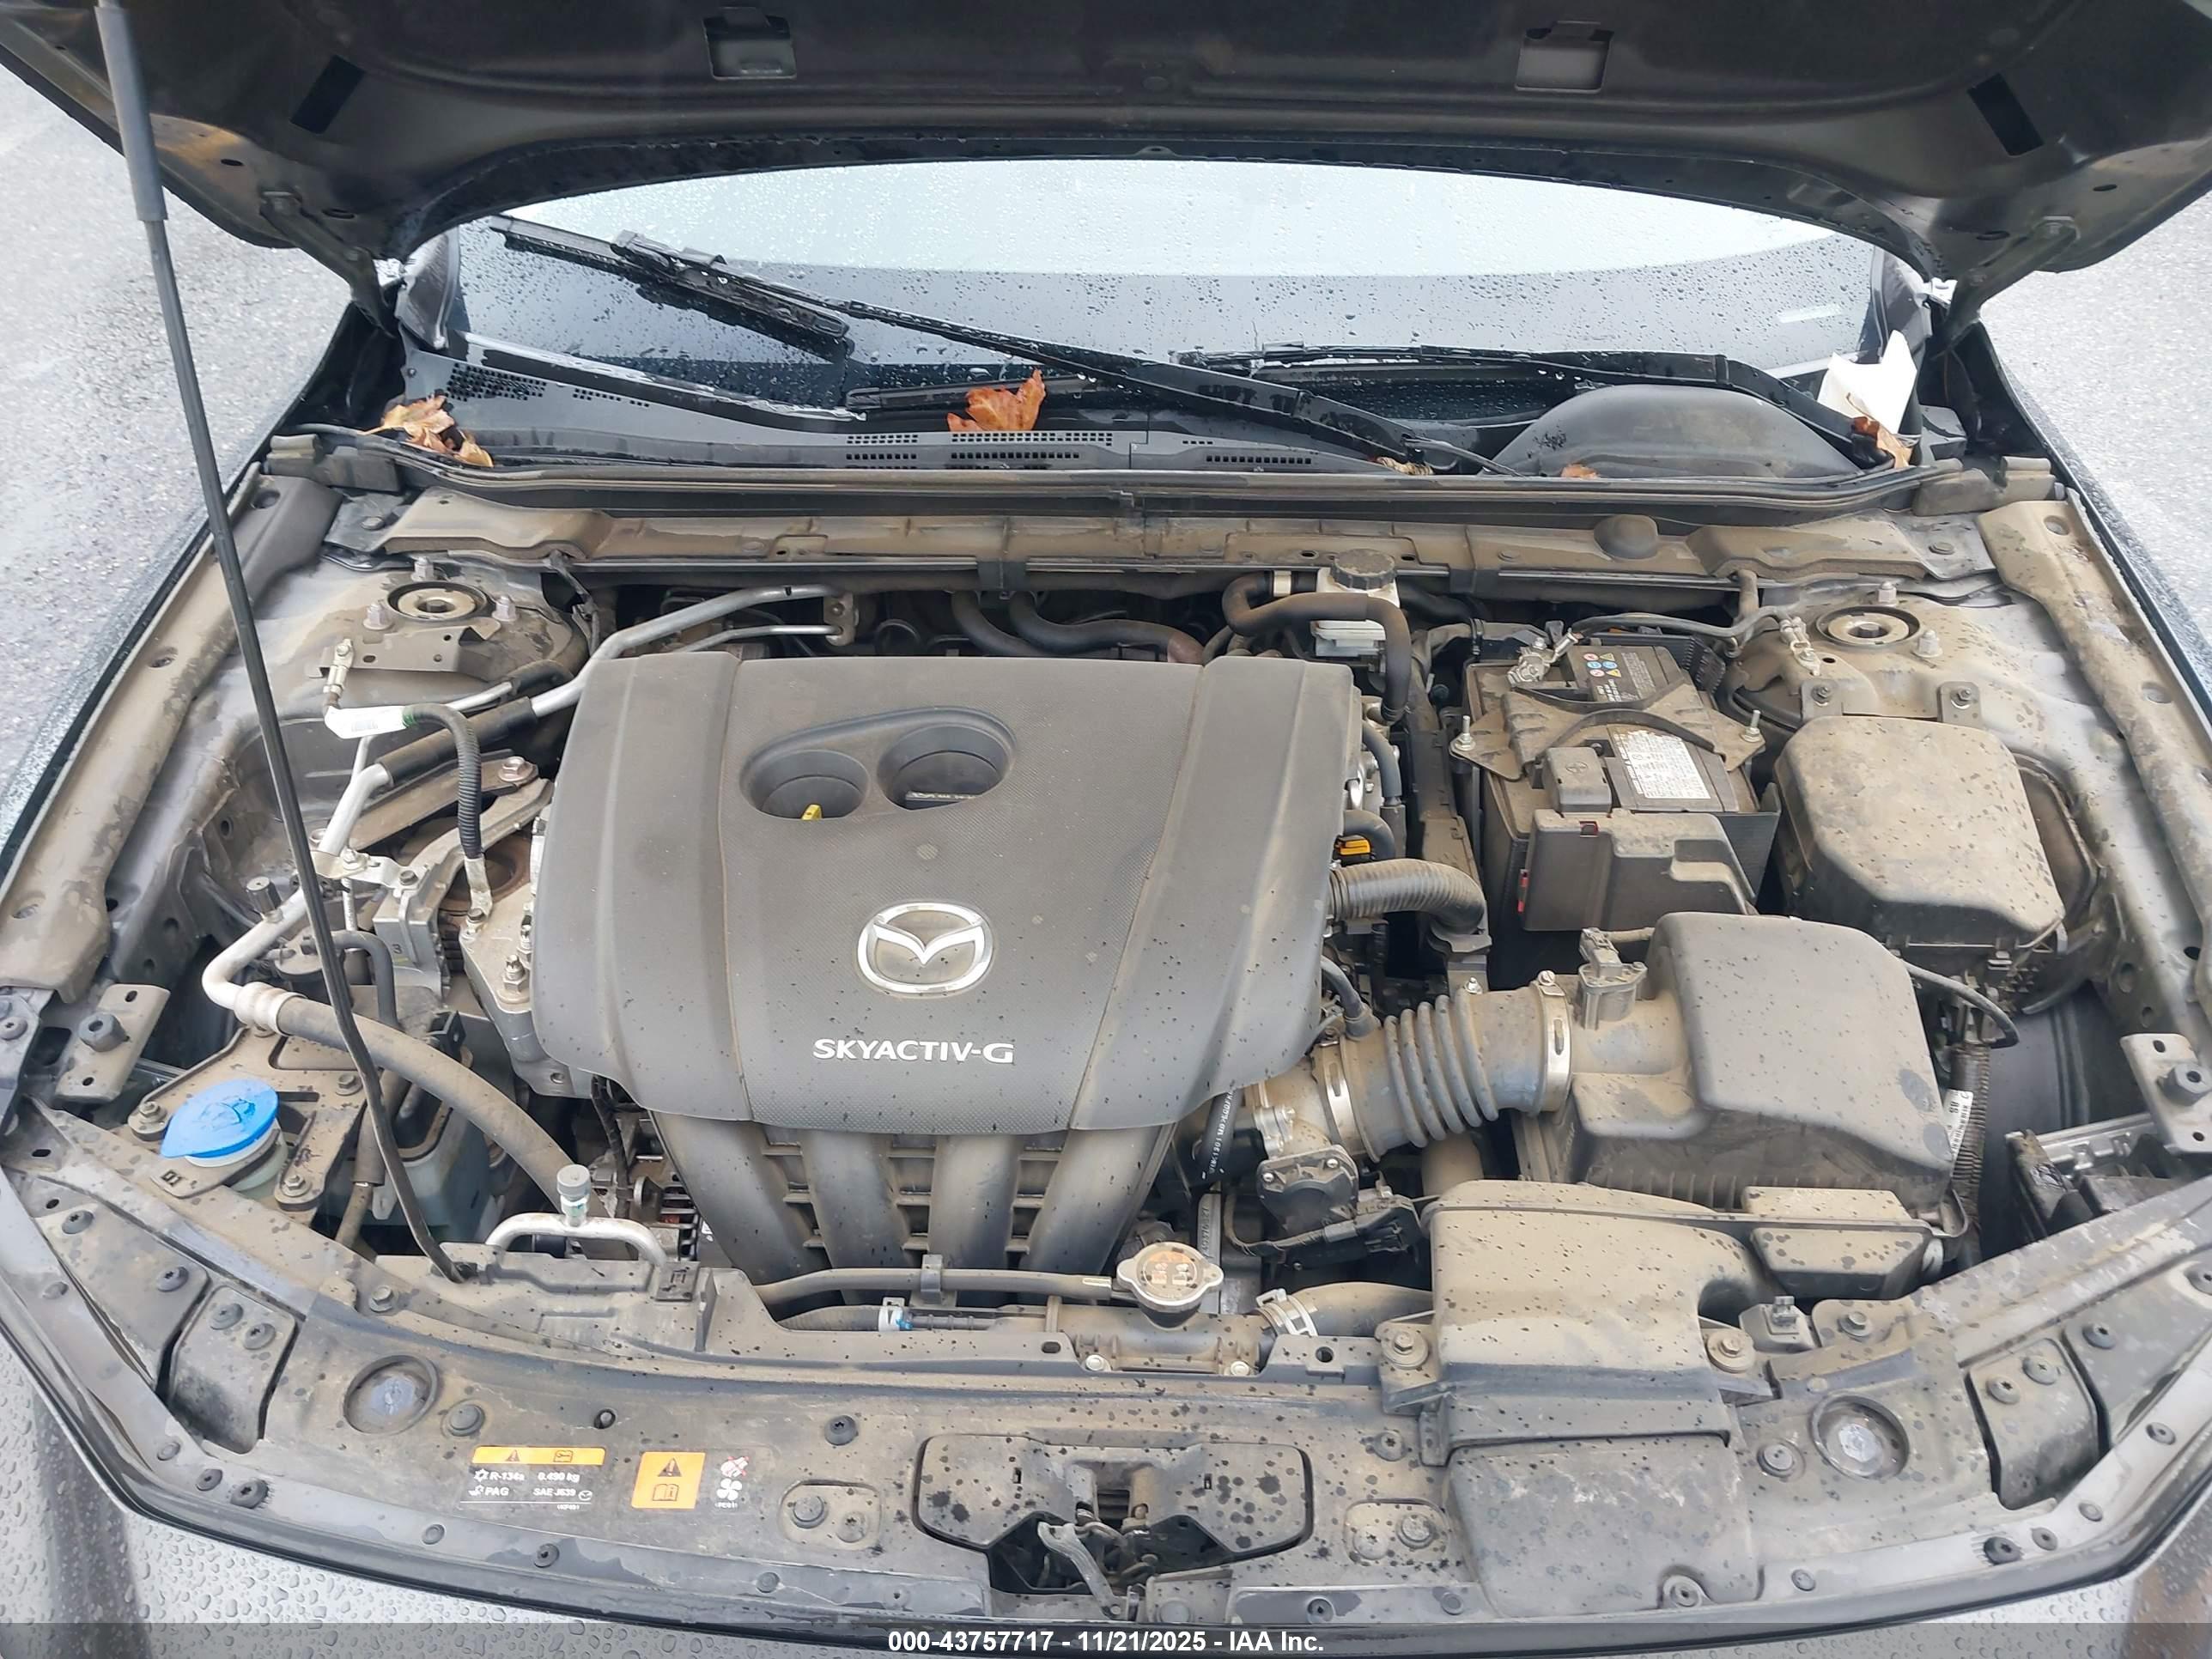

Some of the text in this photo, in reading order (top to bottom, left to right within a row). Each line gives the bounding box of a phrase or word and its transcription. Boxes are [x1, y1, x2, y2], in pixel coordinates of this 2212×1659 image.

[813, 1039, 1014, 1063] SKYACTIV-G
[567, 1472, 580, 1483] kg
[484, 1487, 510, 1496] PAG
[533, 1487, 554, 1497] SAE
